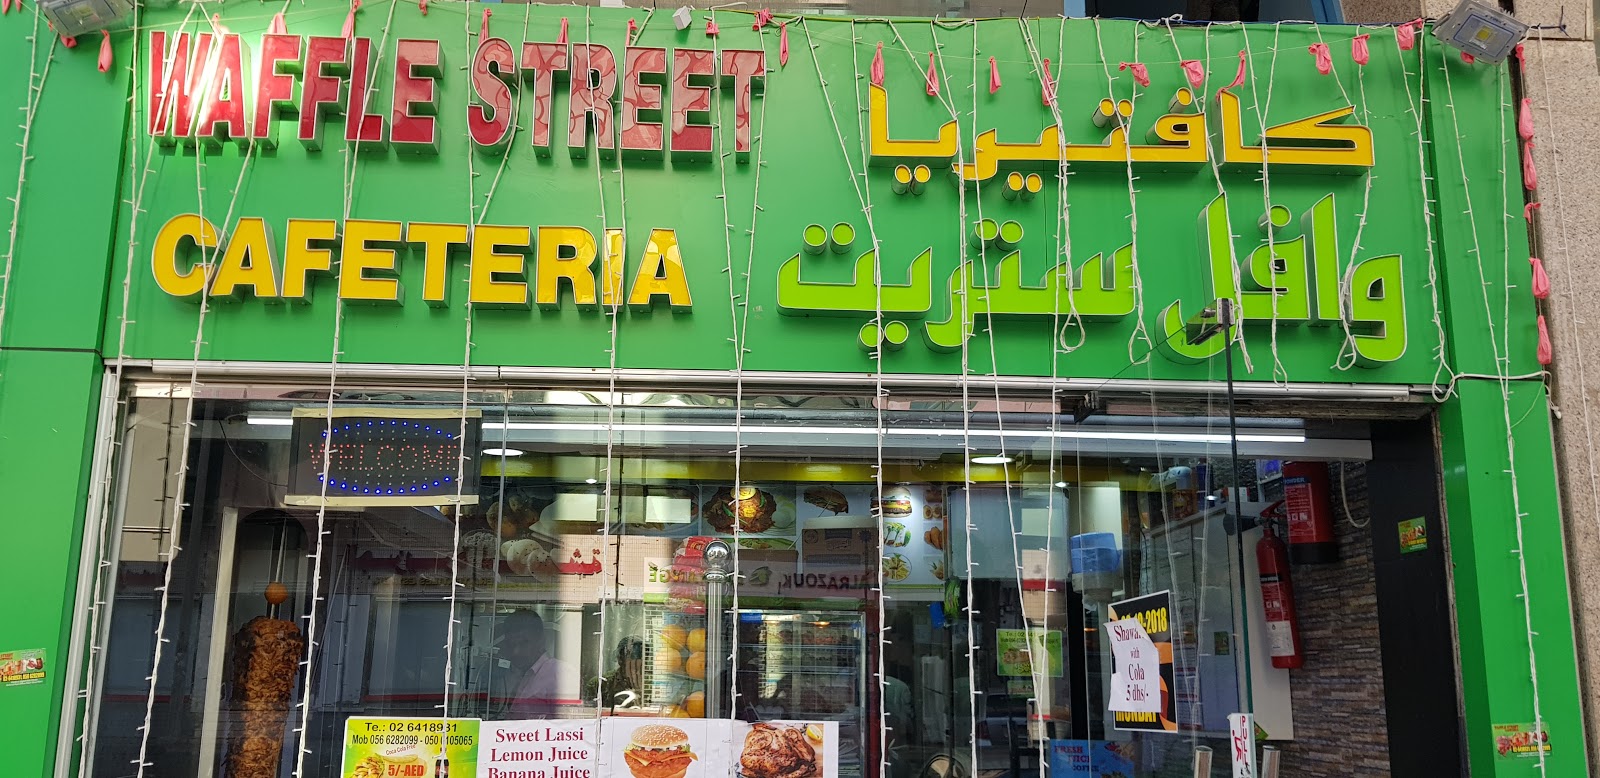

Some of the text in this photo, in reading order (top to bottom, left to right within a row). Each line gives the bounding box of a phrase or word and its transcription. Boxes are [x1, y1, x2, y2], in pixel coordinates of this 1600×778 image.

[148, 31, 766, 162] WAFFLE STREET
[868, 82, 1374, 199] كافتيريا
[152, 212, 692, 313] CAFETERIA
[777, 191, 1408, 368] وافل ستريت
[309, 443, 461, 471] WELCOME
[1130, 647, 1140, 659] with
[1128, 663, 1145, 681] Cola
[1126, 684, 1131, 701] 5
[365, 722, 385, 732] Te.:
[389, 722, 404, 732] 02
[495, 727, 584, 743] Sweet Lassi
[352, 734, 368, 745] Mob
[369, 734, 384, 745] 056
[385, 734, 418, 745] 6282099
[424, 735, 438, 746] 050
[385, 743, 416, 756] Coca Cola Free
[490, 746, 588, 763] Lemon Juice
[388, 765, 424, 777] 5/-AED
[487, 765, 591, 778] Banana Juice
